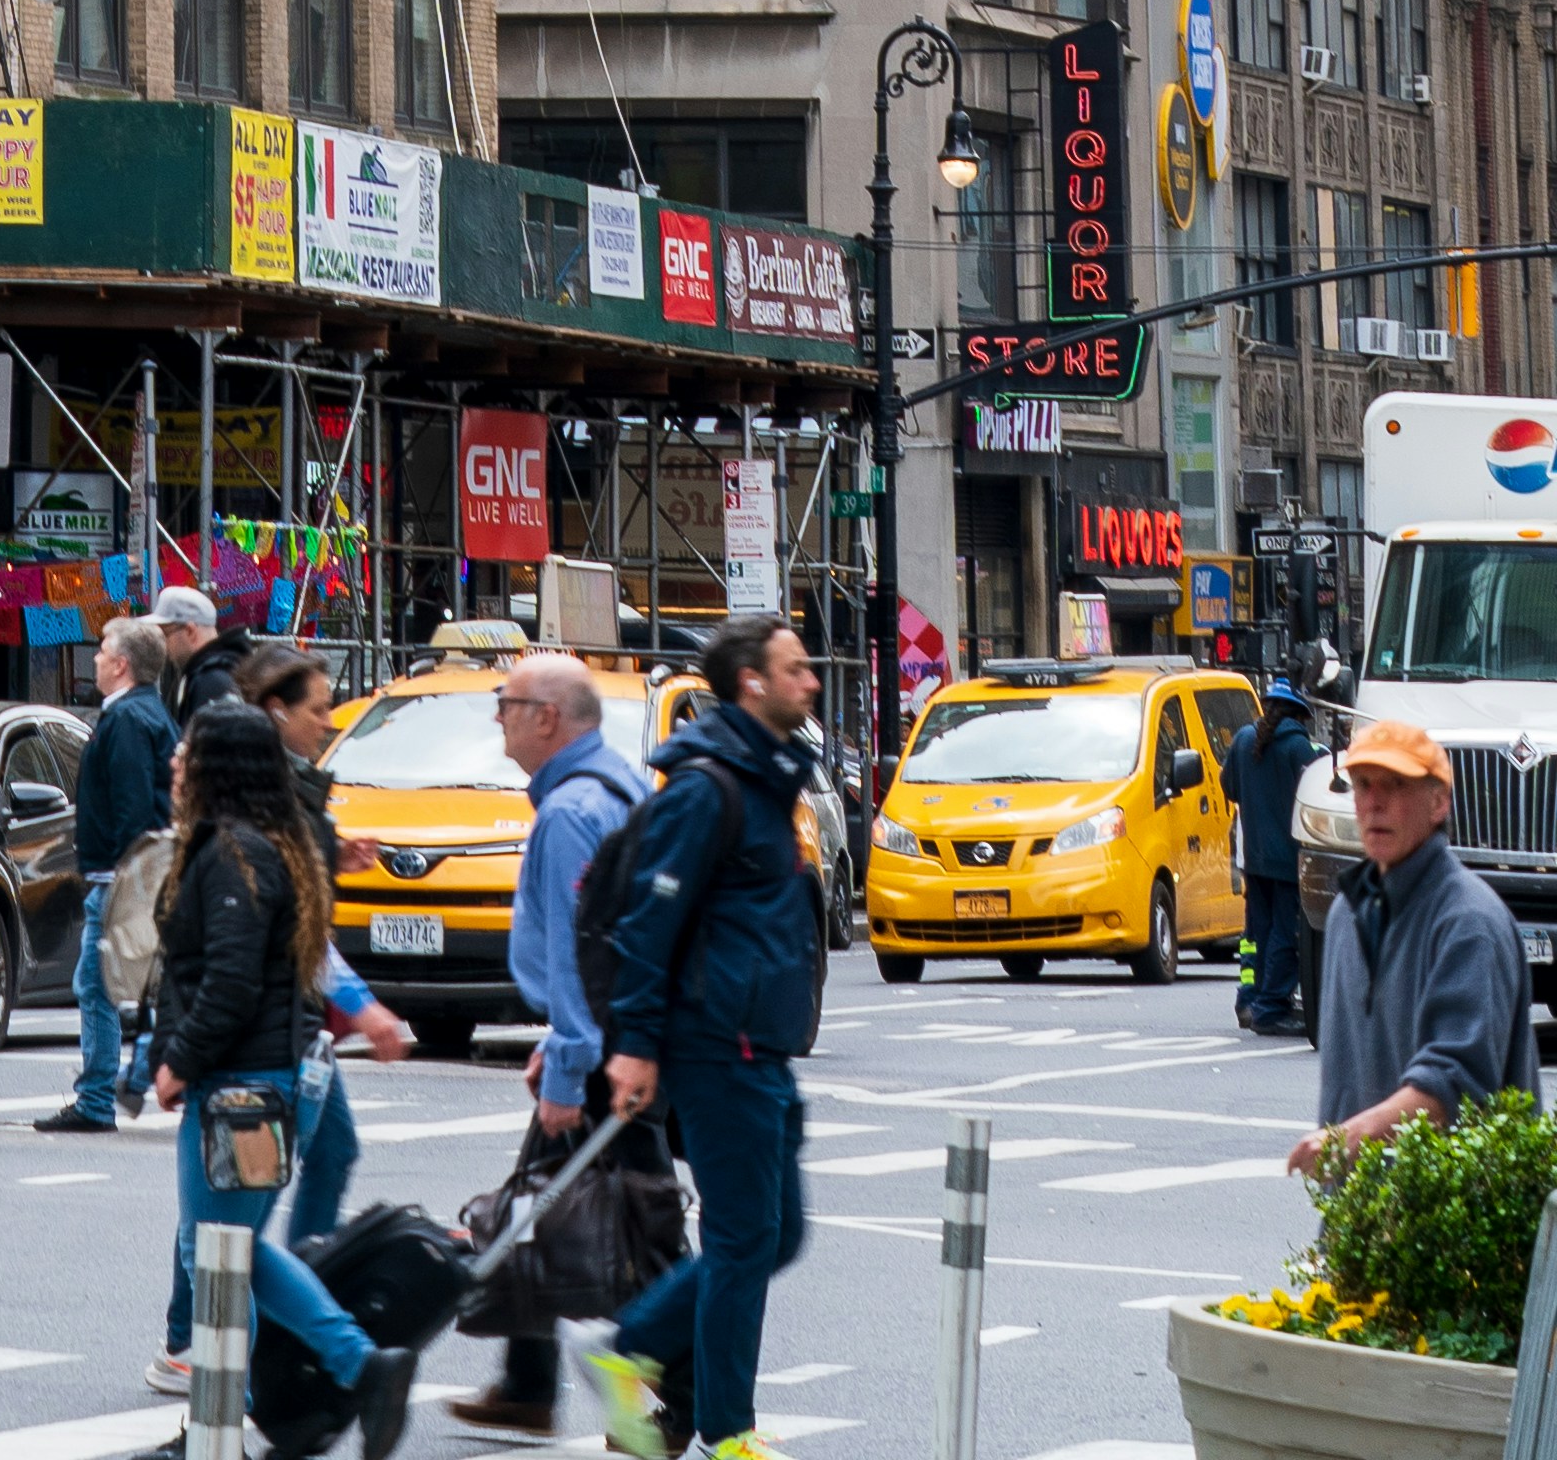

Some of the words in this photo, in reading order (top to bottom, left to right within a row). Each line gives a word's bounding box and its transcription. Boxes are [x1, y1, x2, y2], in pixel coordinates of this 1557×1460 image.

[234, 121, 259, 155] ALL
[263, 124, 288, 160] DAY
[1063, 43, 1110, 303] LIQUOR
[3, 208, 37, 217] BEERS
[6, 196, 33, 205] WINE
[258, 210, 287, 240] HOUR
[362, 256, 435, 297] RESTAURANT
[663, 236, 709, 281] GNC
[745, 235, 805, 297] Berlina
[665, 279, 685, 297] LIVE
[687, 281, 711, 301] WELL
[892, 333, 921, 351] WAY
[968, 334, 1121, 379] STORE
[1013, 400, 1062, 453] PIZZA
[465, 444, 544, 499] GNC
[469, 504, 502, 525] LIVE
[506, 504, 544, 527] WELL
[841, 495, 857, 511] 39
[1081, 504, 1183, 569] LIQUORS
[1195, 570, 1212, 596] PAY
